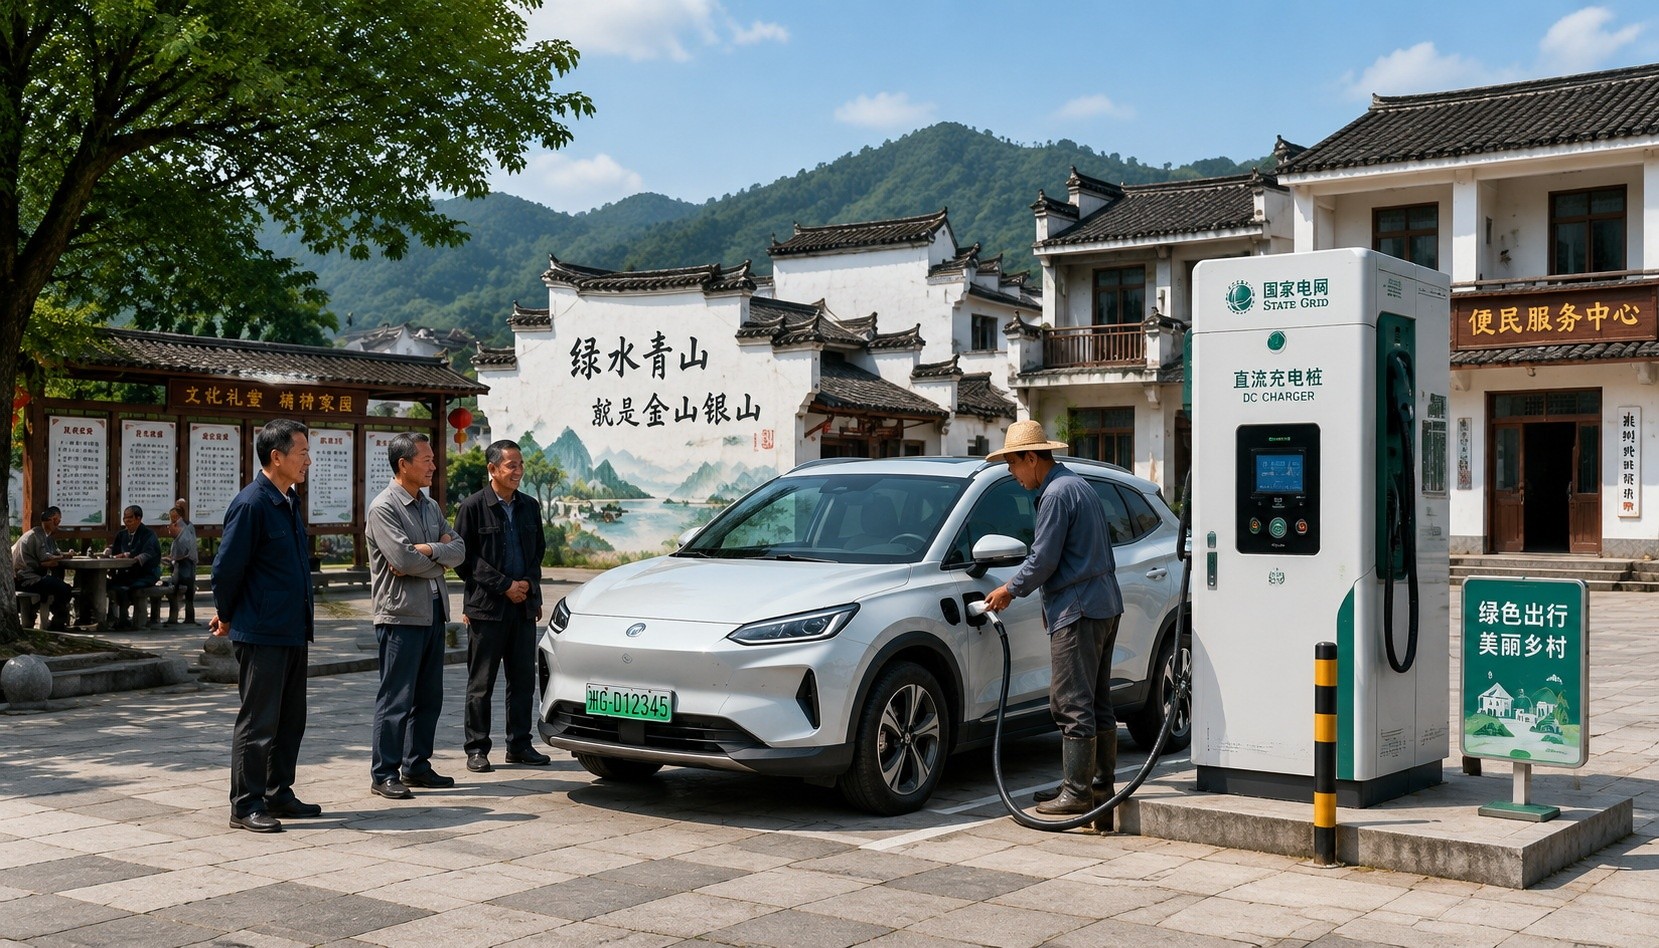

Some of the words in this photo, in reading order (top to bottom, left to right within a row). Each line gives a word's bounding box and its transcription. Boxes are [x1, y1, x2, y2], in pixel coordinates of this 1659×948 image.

[1263, 278, 1329, 299] 国家电网
[1263, 300, 1296, 311] STATE
[1300, 298, 1329, 308] GRID
[1468, 301, 1640, 336] 便民服务中心
[569, 330, 709, 381] 绿水青山
[1243, 392, 1258, 403] DC
[1262, 391, 1315, 402] CHARGER
[1478, 600, 1568, 628] 绿色出行
[1479, 631, 1567, 659] 美丽乡村
